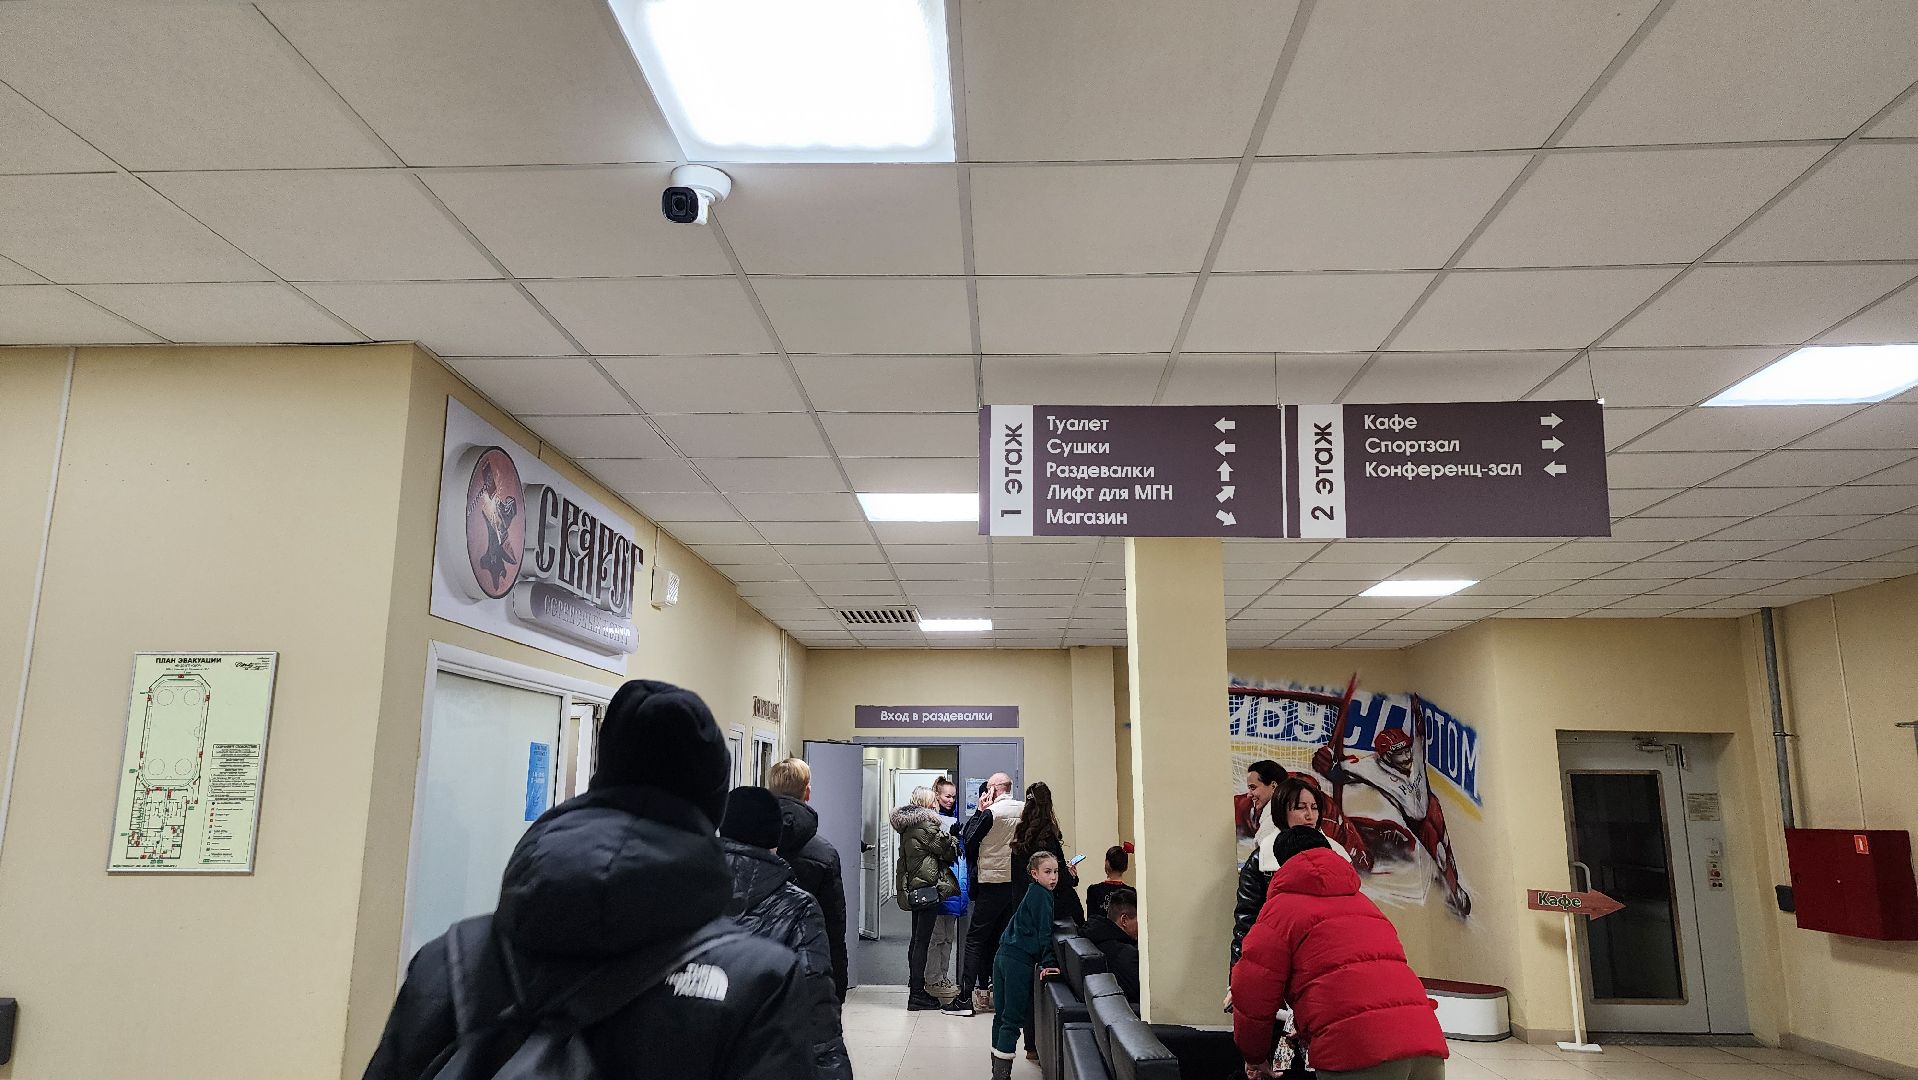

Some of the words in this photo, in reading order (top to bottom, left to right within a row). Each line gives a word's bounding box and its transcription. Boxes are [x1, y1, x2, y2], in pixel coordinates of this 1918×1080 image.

[1046, 415, 1110, 434] Туалет
[1364, 414, 1418, 432] Кафе
[1046, 438, 1110, 457] Сушки
[1365, 437, 1460, 456] Спортзал
[1046, 461, 1155, 480] Раздевалки
[1365, 461, 1522, 480] Конференц-зал
[1047, 484, 1095, 503] Лифт
[1098, 488, 1129, 502] для
[1134, 484, 1173, 501] МГН
[1000, 509, 1022, 518] 1
[1046, 508, 1128, 525] Магазин
[1310, 505, 1334, 521] 2
[880, 710, 910, 723] Вход
[912, 713, 919, 721] в
[922, 711, 993, 723] раздевалки
[1538, 891, 1582, 910] Кафе
